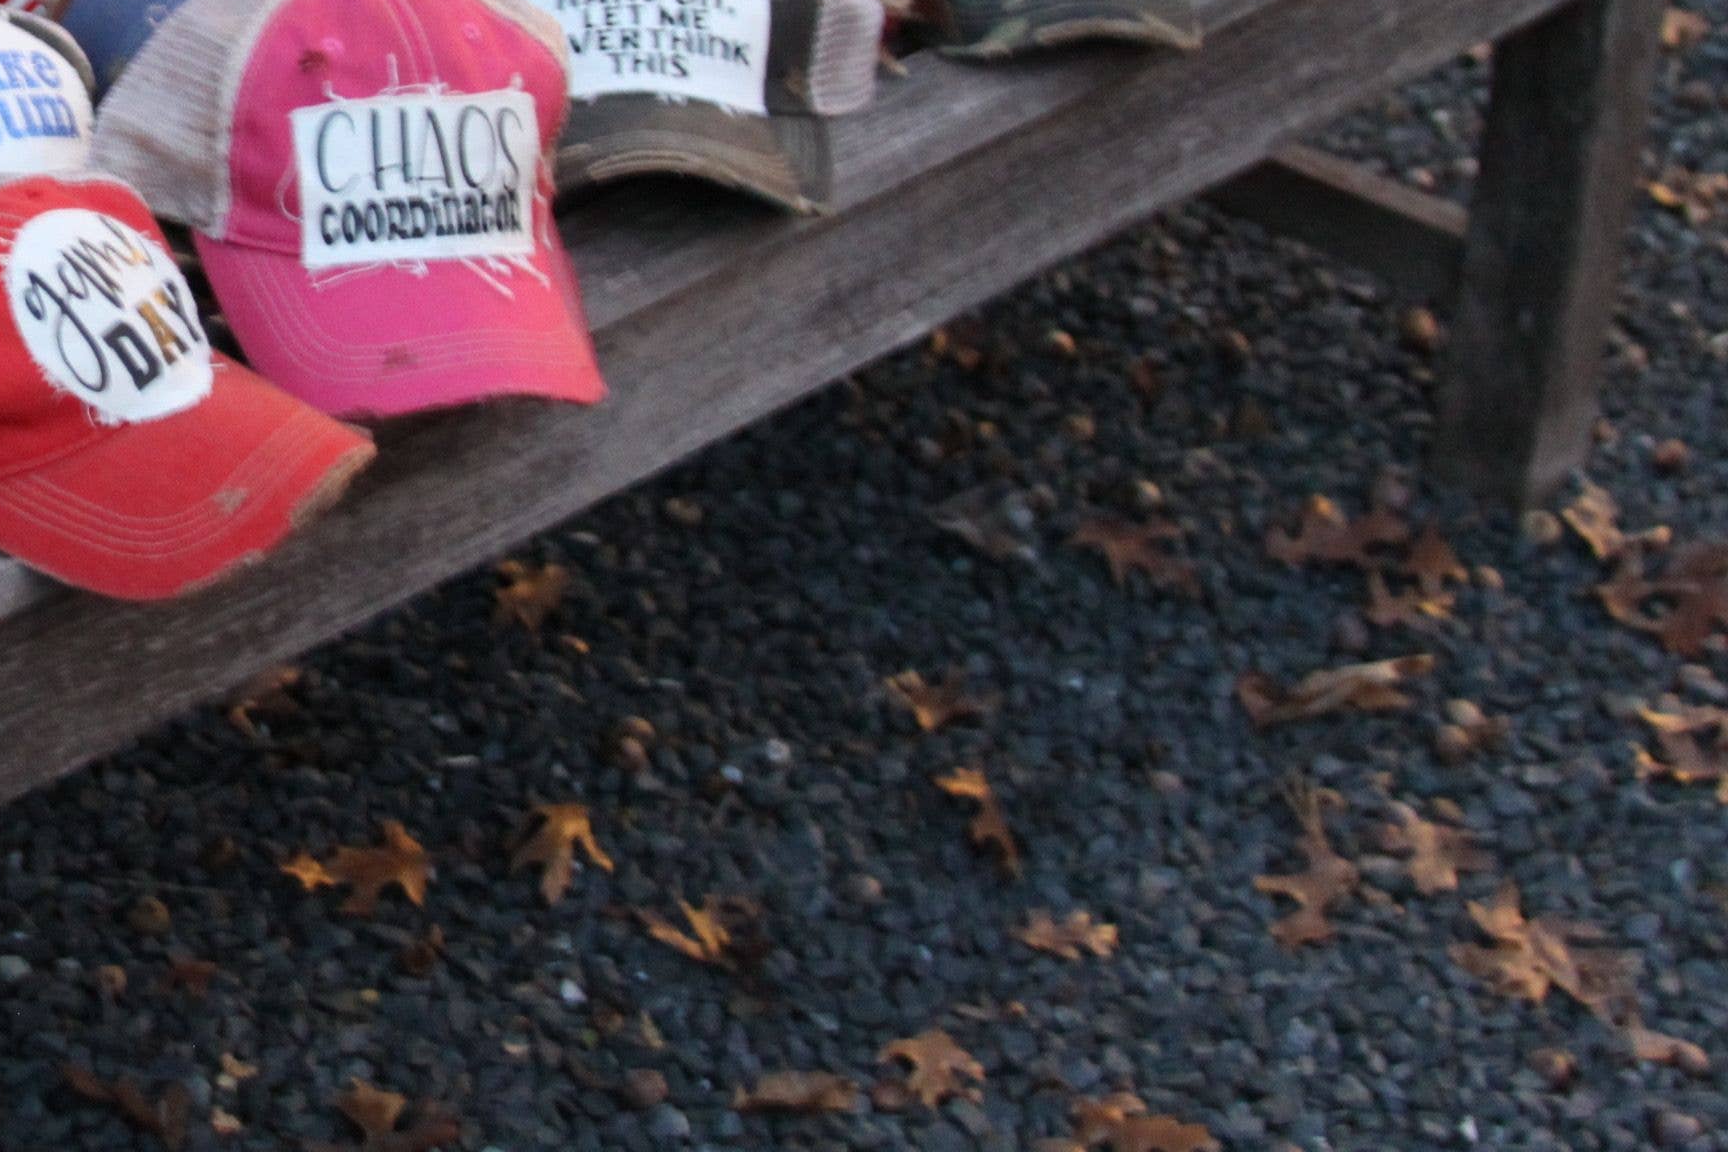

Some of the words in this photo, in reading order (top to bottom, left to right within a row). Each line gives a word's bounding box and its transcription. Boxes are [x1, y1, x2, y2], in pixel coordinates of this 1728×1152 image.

[583, 4, 643, 29] LET
[660, 6, 711, 30] ME
[567, 28, 751, 67] VERTHINK
[607, 52, 689, 78] THIS
[316, 104, 524, 193] CHAOS
[102, 279, 202, 392] DAY
